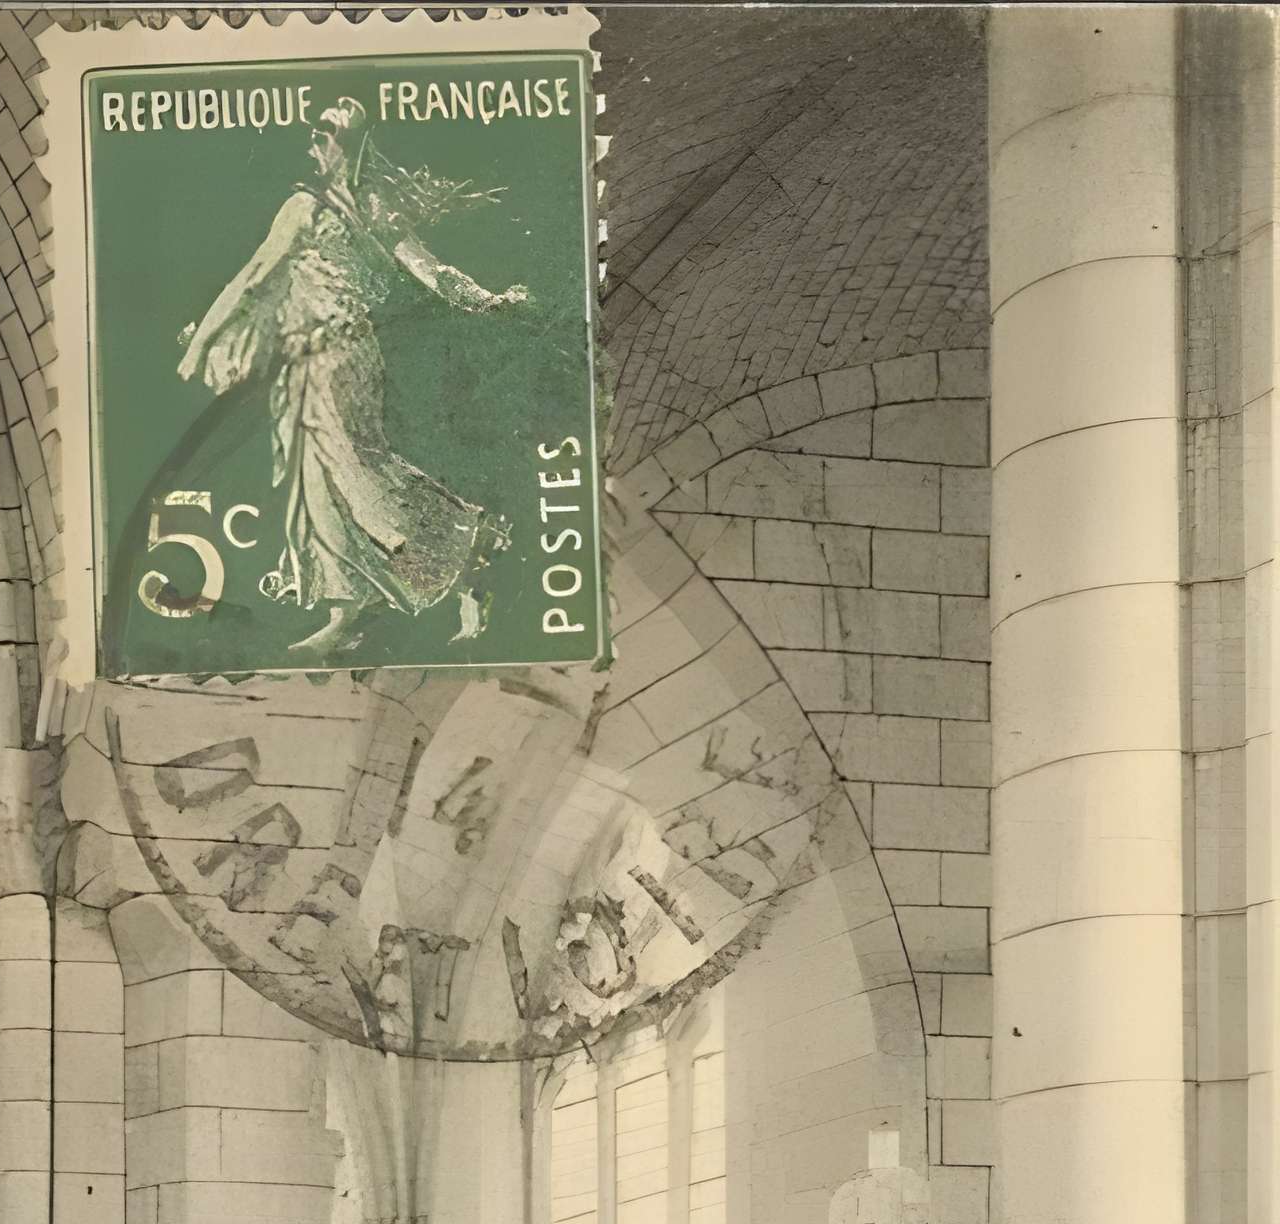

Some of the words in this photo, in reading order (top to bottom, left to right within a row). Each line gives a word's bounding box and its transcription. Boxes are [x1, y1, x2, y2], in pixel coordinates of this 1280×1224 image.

[102, 85, 312, 133] REPUBLIQUE
[378, 77, 571, 125] FRANÇAISE
[538, 435, 584, 634] POSTES
